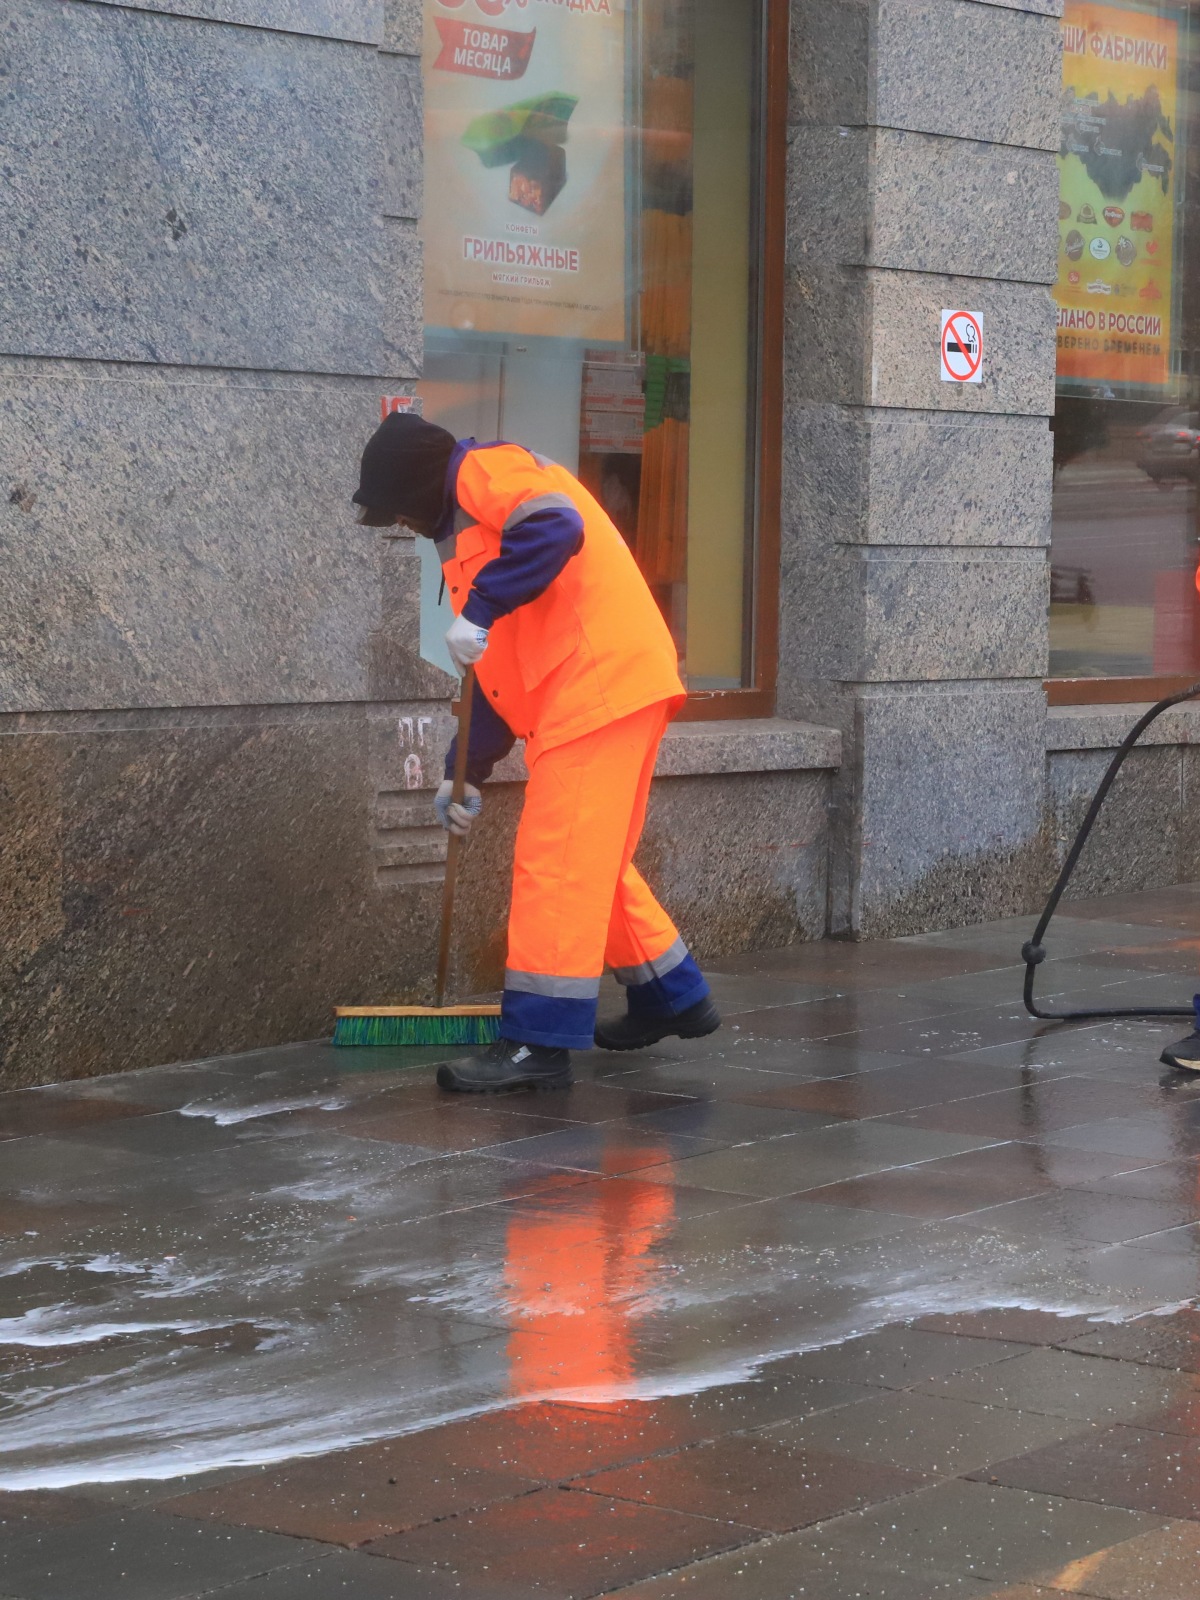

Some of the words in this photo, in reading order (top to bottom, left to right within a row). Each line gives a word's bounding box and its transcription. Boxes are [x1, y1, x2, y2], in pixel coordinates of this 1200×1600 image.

[463, 28, 509, 52] ТОВАР
[1090, 31, 1167, 70] ФАБРИКИ
[454, 47, 511, 76] МЕСЯЦА
[505, 223, 538, 235] КОНФЕТЫ
[464, 238, 578, 271] ГРИЛЬЯЖНЫЕ
[492, 272, 519, 284] МЯГКИЙ
[520, 277, 551, 287] ГРИЛЬЯЖ
[1098, 312, 1106, 331] В
[1108, 313, 1161, 336] РОССИИ
